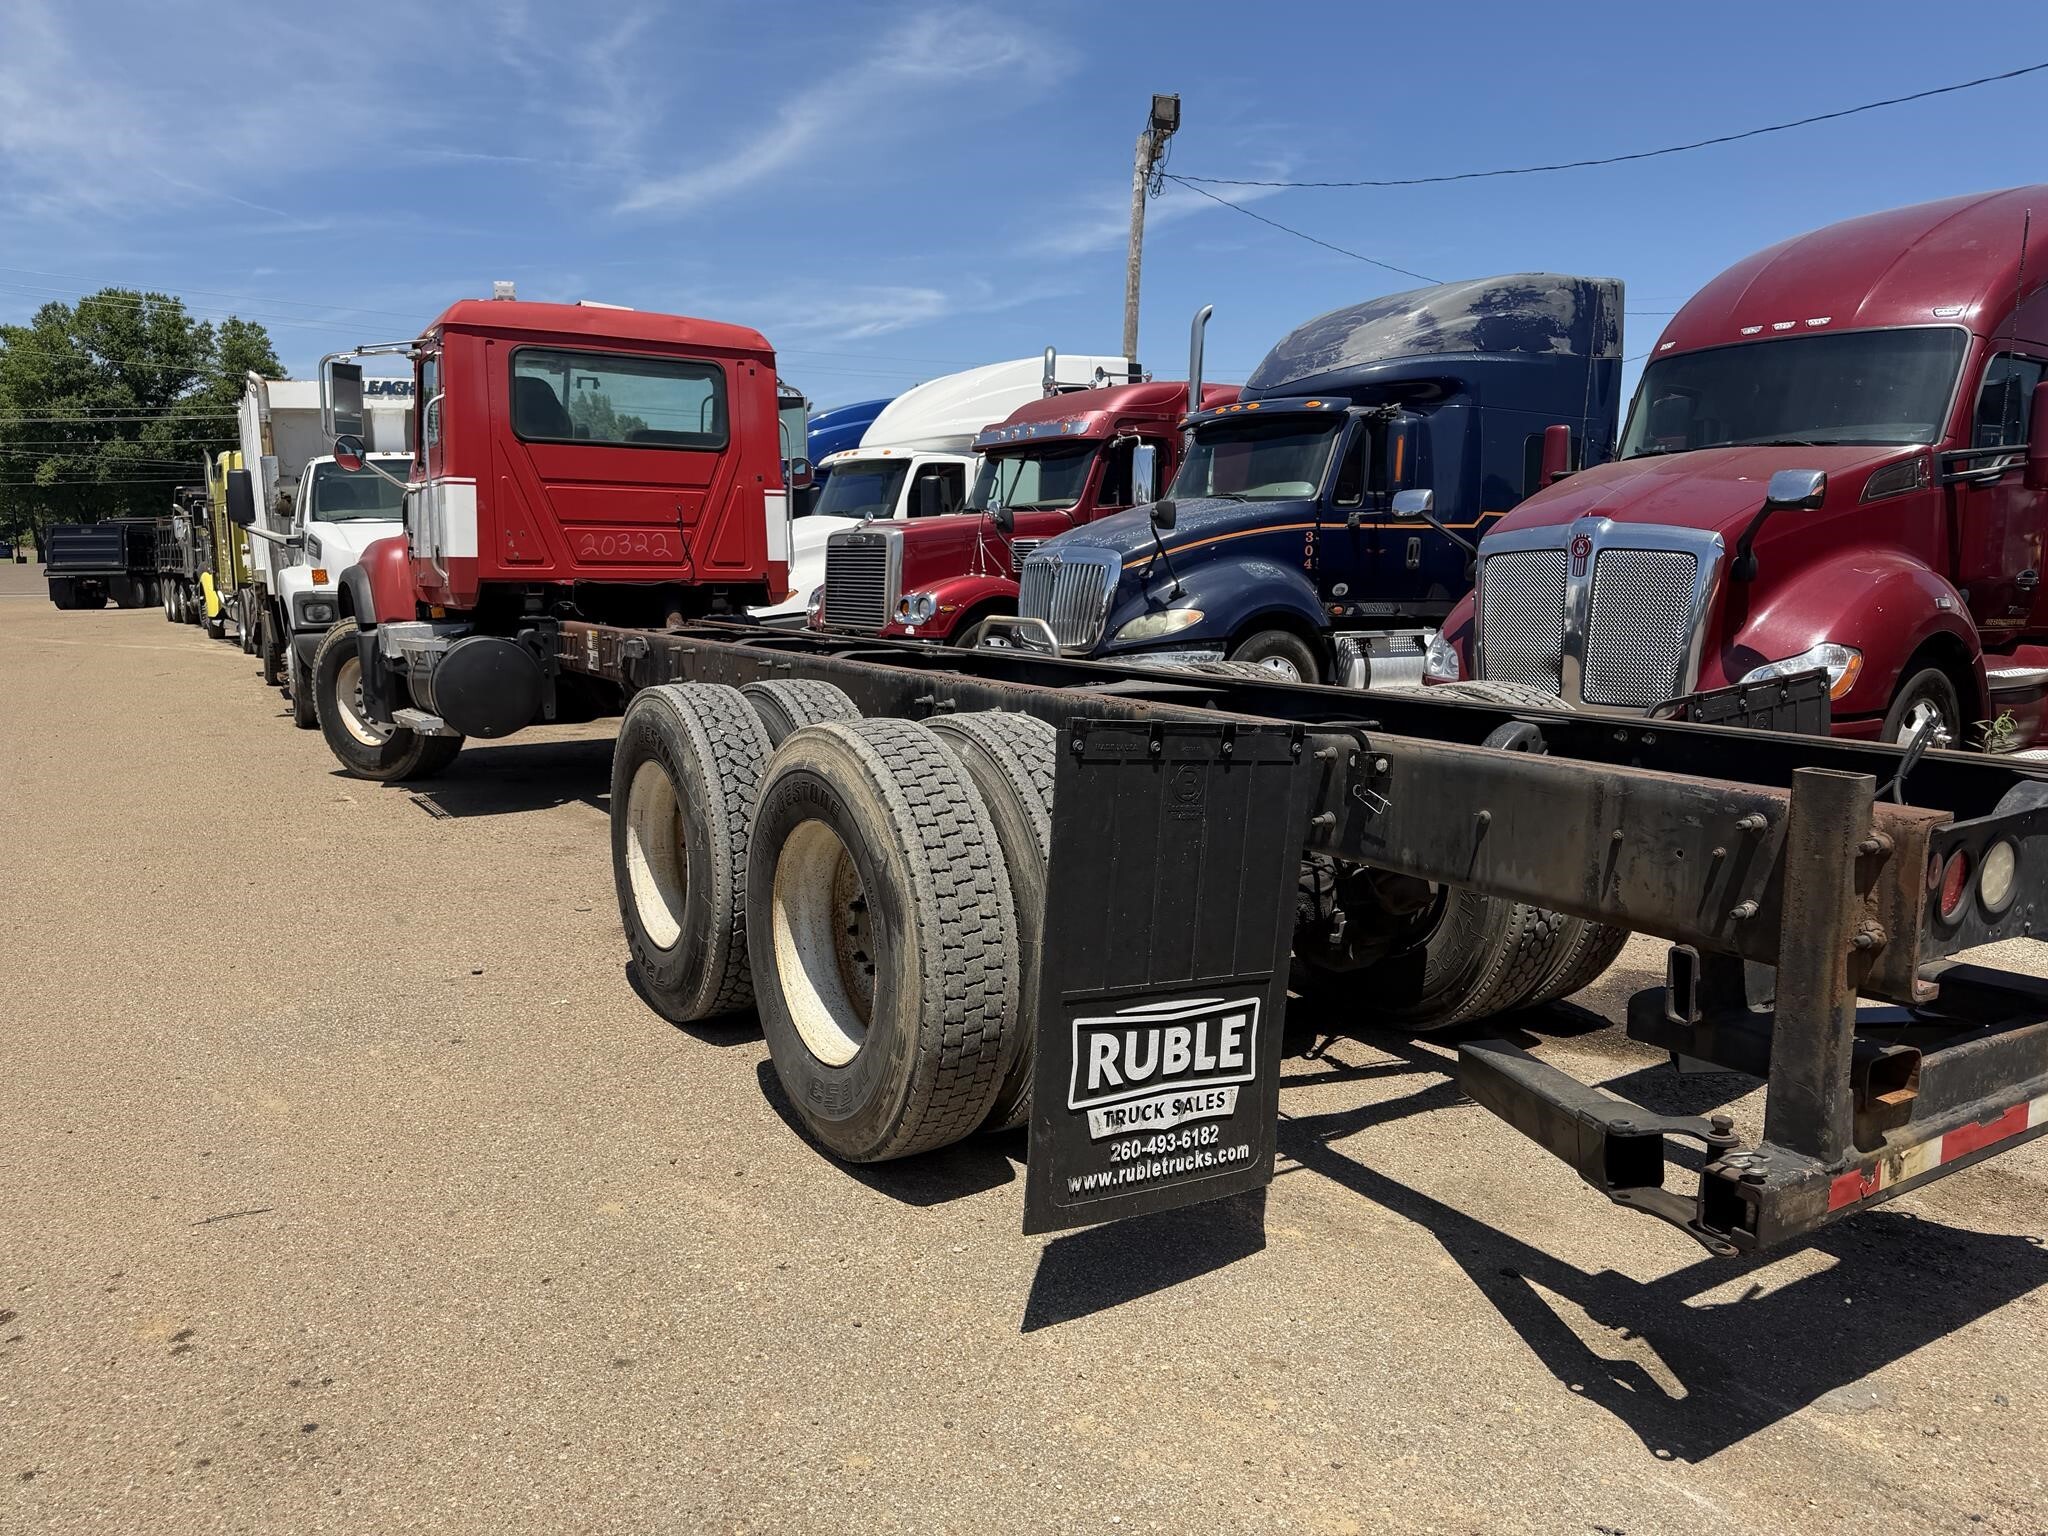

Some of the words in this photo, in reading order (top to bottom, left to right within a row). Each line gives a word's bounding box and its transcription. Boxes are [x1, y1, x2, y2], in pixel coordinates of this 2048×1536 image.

[580, 532, 673, 557] 20322
[1303, 531, 1314, 569] 304
[1087, 1014, 1247, 1090] RUBLE
[1103, 1102, 1165, 1129] TRUCK
[1171, 1091, 1226, 1117] SALES
[1110, 1124, 1220, 1162] 260-493-6182
[1067, 1143, 1250, 1194] www.rubletrucks.com
